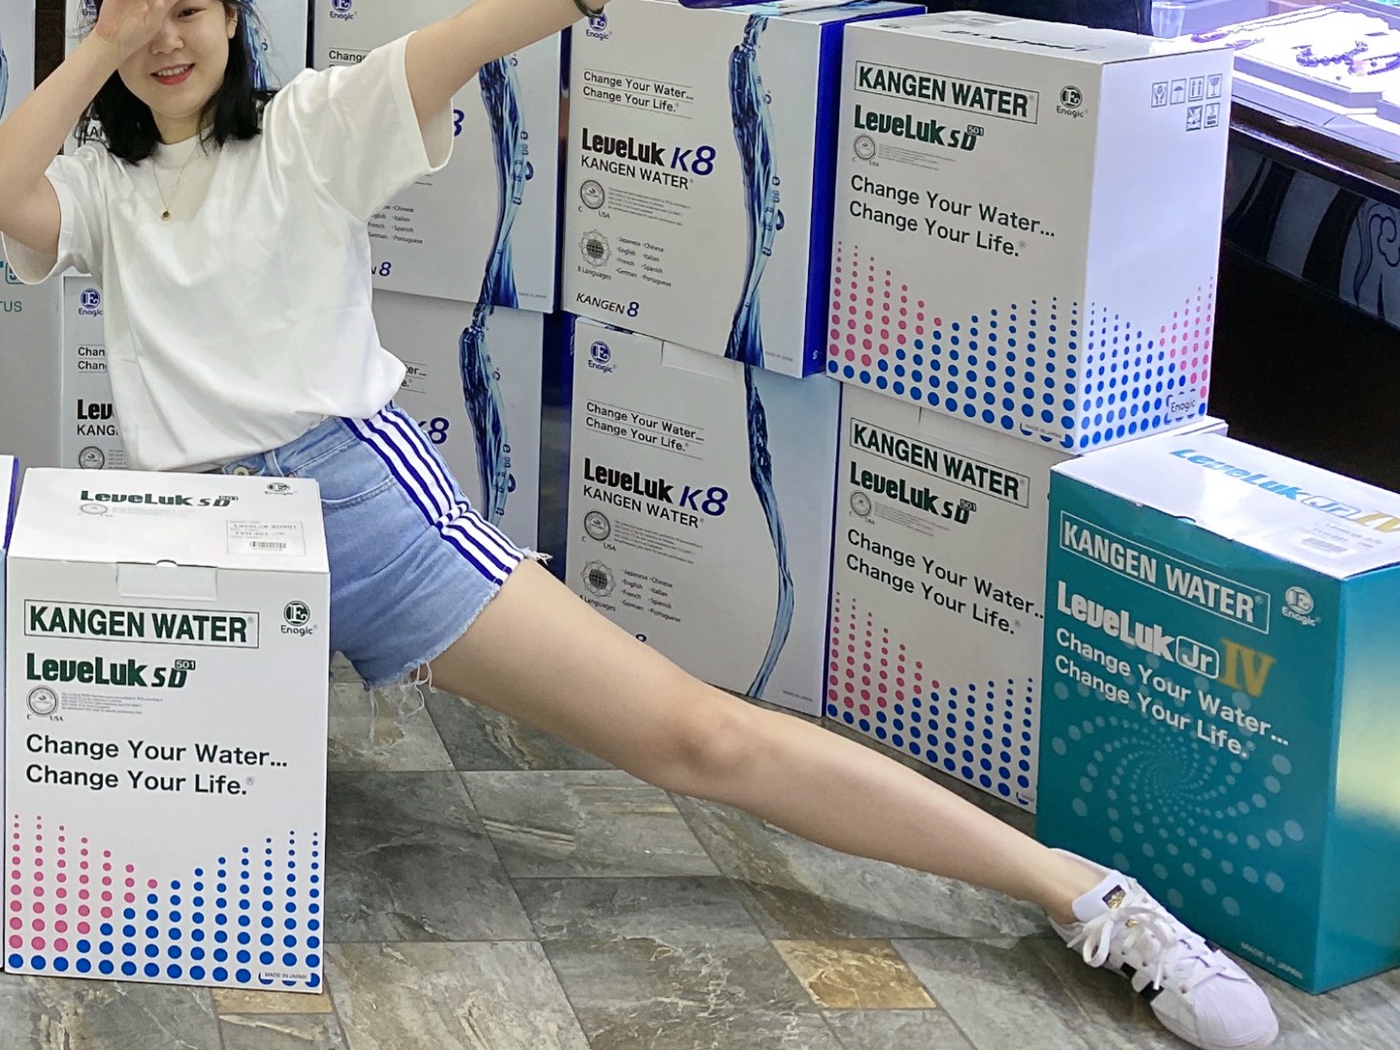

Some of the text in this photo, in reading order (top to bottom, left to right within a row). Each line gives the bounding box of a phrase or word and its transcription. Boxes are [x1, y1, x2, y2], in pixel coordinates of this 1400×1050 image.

[586, 29, 609, 41] Enagic
[859, 66, 1029, 118] KANGEN WATER
[1056, 106, 1084, 119] Enagic
[854, 105, 945, 146] LeveLuk
[581, 155, 689, 190] KANGEN WATER
[582, 128, 716, 175] LeveLuk K8
[851, 174, 920, 206] Change
[926, 191, 971, 217] Your
[849, 200, 918, 232] Change
[924, 218, 970, 245] Your
[854, 423, 1020, 501] KANGEN WATER
[583, 485, 699, 528] KANGEN WATER
[584, 458, 729, 516] LeveLuk K8
[850, 461, 939, 515] LeveLuk
[1064, 521, 1255, 624] KANGEN WATER
[30, 605, 247, 643] KANGEN WATER
[281, 624, 313, 636] Enagic
[1057, 580, 1175, 662] LeveLuk
[1282, 606, 1316, 627] Enagic
[27, 653, 149, 687] LeveLuk
[1056, 627, 1130, 676] Change
[1138, 663, 1191, 702] Your
[1055, 654, 1130, 704] Change
[1137, 692, 1190, 730] Your
[26, 734, 287, 767] Change Your Water...
[26, 764, 247, 795] Change Your Life.
